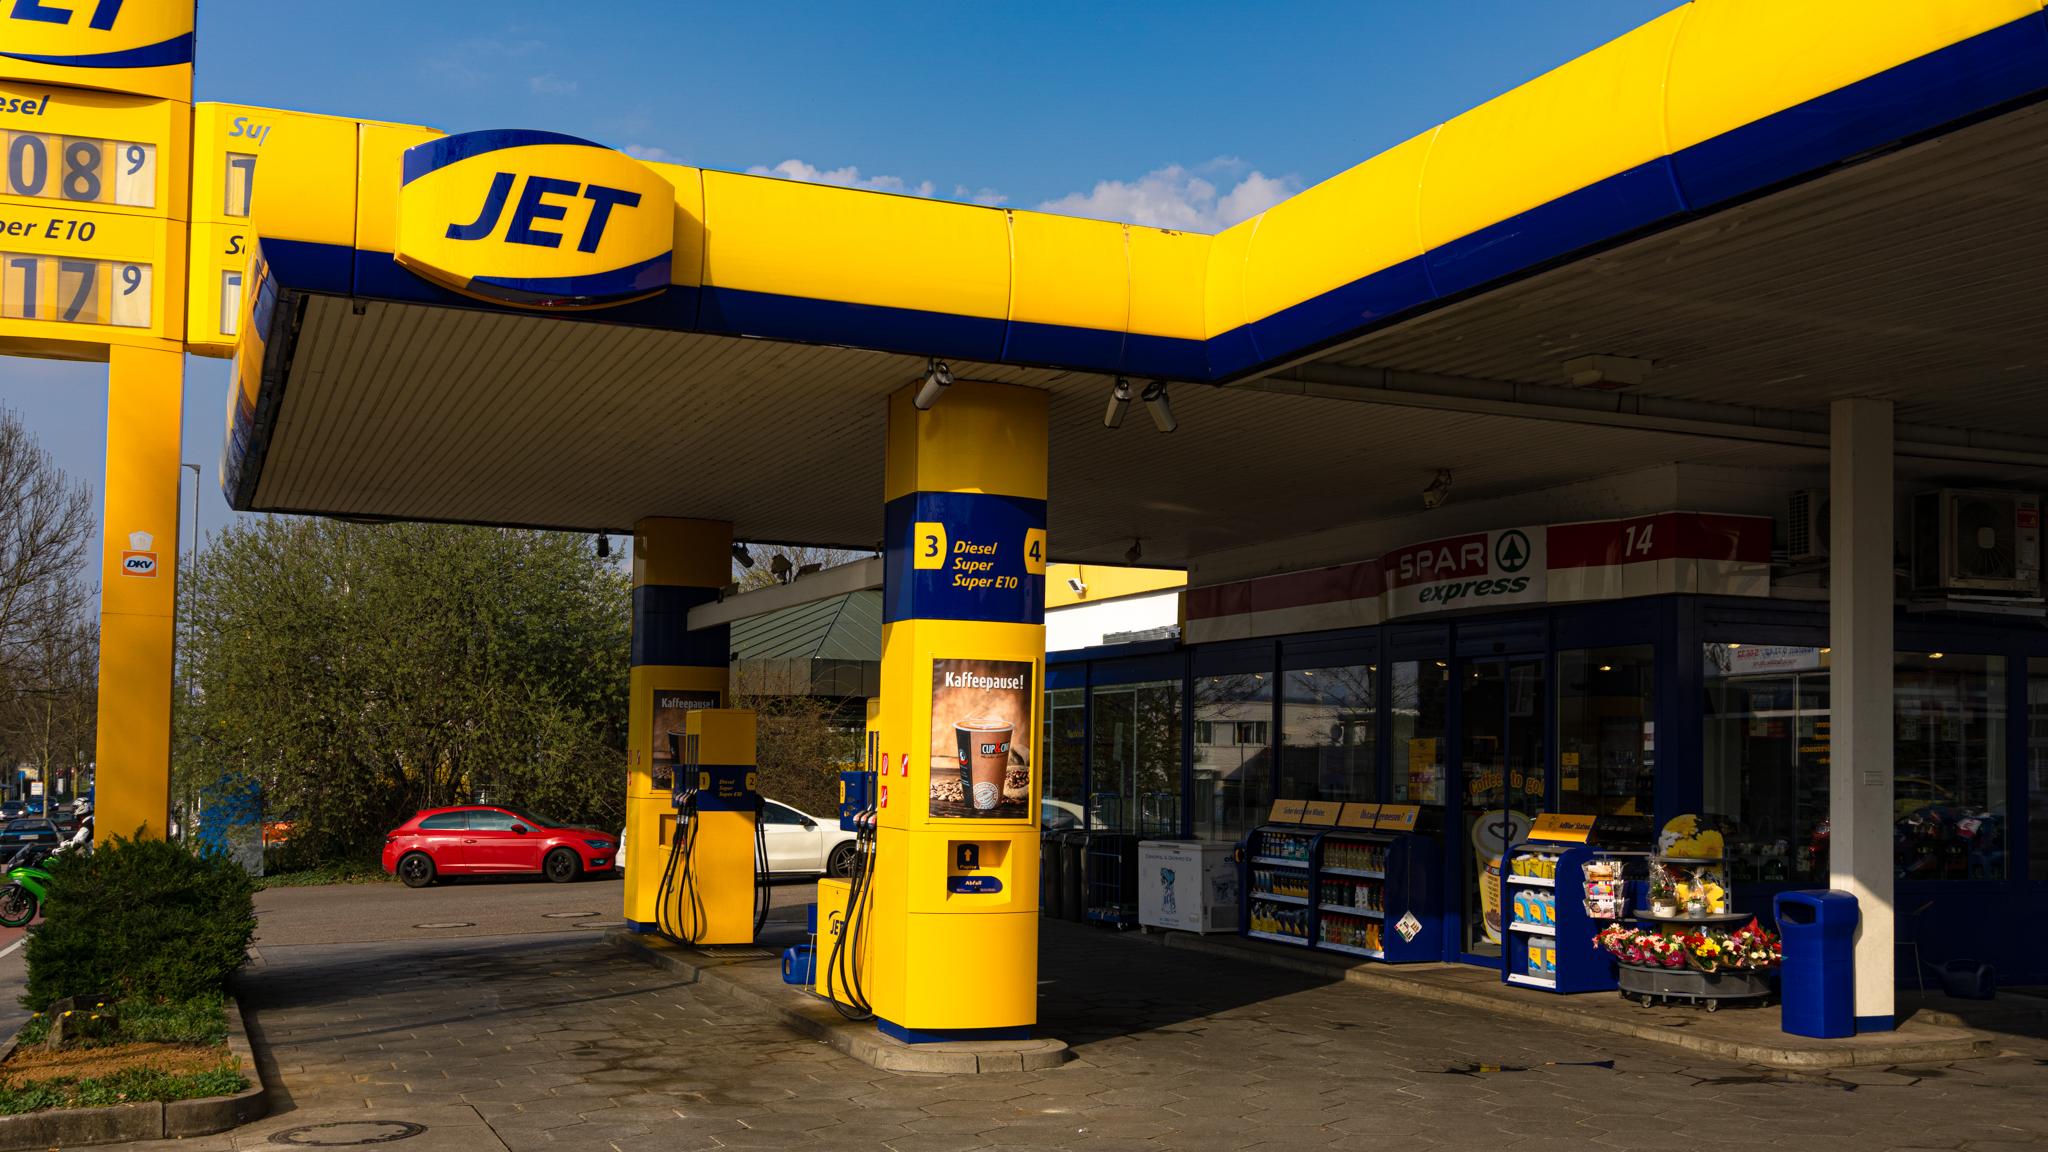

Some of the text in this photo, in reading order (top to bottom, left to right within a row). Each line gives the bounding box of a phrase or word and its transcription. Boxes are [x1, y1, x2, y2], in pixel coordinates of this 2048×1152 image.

[126, 145, 146, 176] 9
[445, 171, 642, 254] JET
[44, 218, 96, 242] E10
[123, 265, 142, 296] 9
[924, 535, 939, 558] 3
[953, 540, 998, 555] Diesel
[1029, 540, 1042, 562] 4
[1625, 523, 1655, 557] 14
[126, 559, 153, 569] DKV
[952, 557, 994, 575] Super
[1400, 542, 1485, 579] SPAR
[952, 573, 1018, 591] Super E10
[1419, 576, 1530, 604] express
[945, 671, 1024, 692] Kaffeepause!
[1470, 769, 1502, 794] Coffee
[1511, 769, 1522, 788] to
